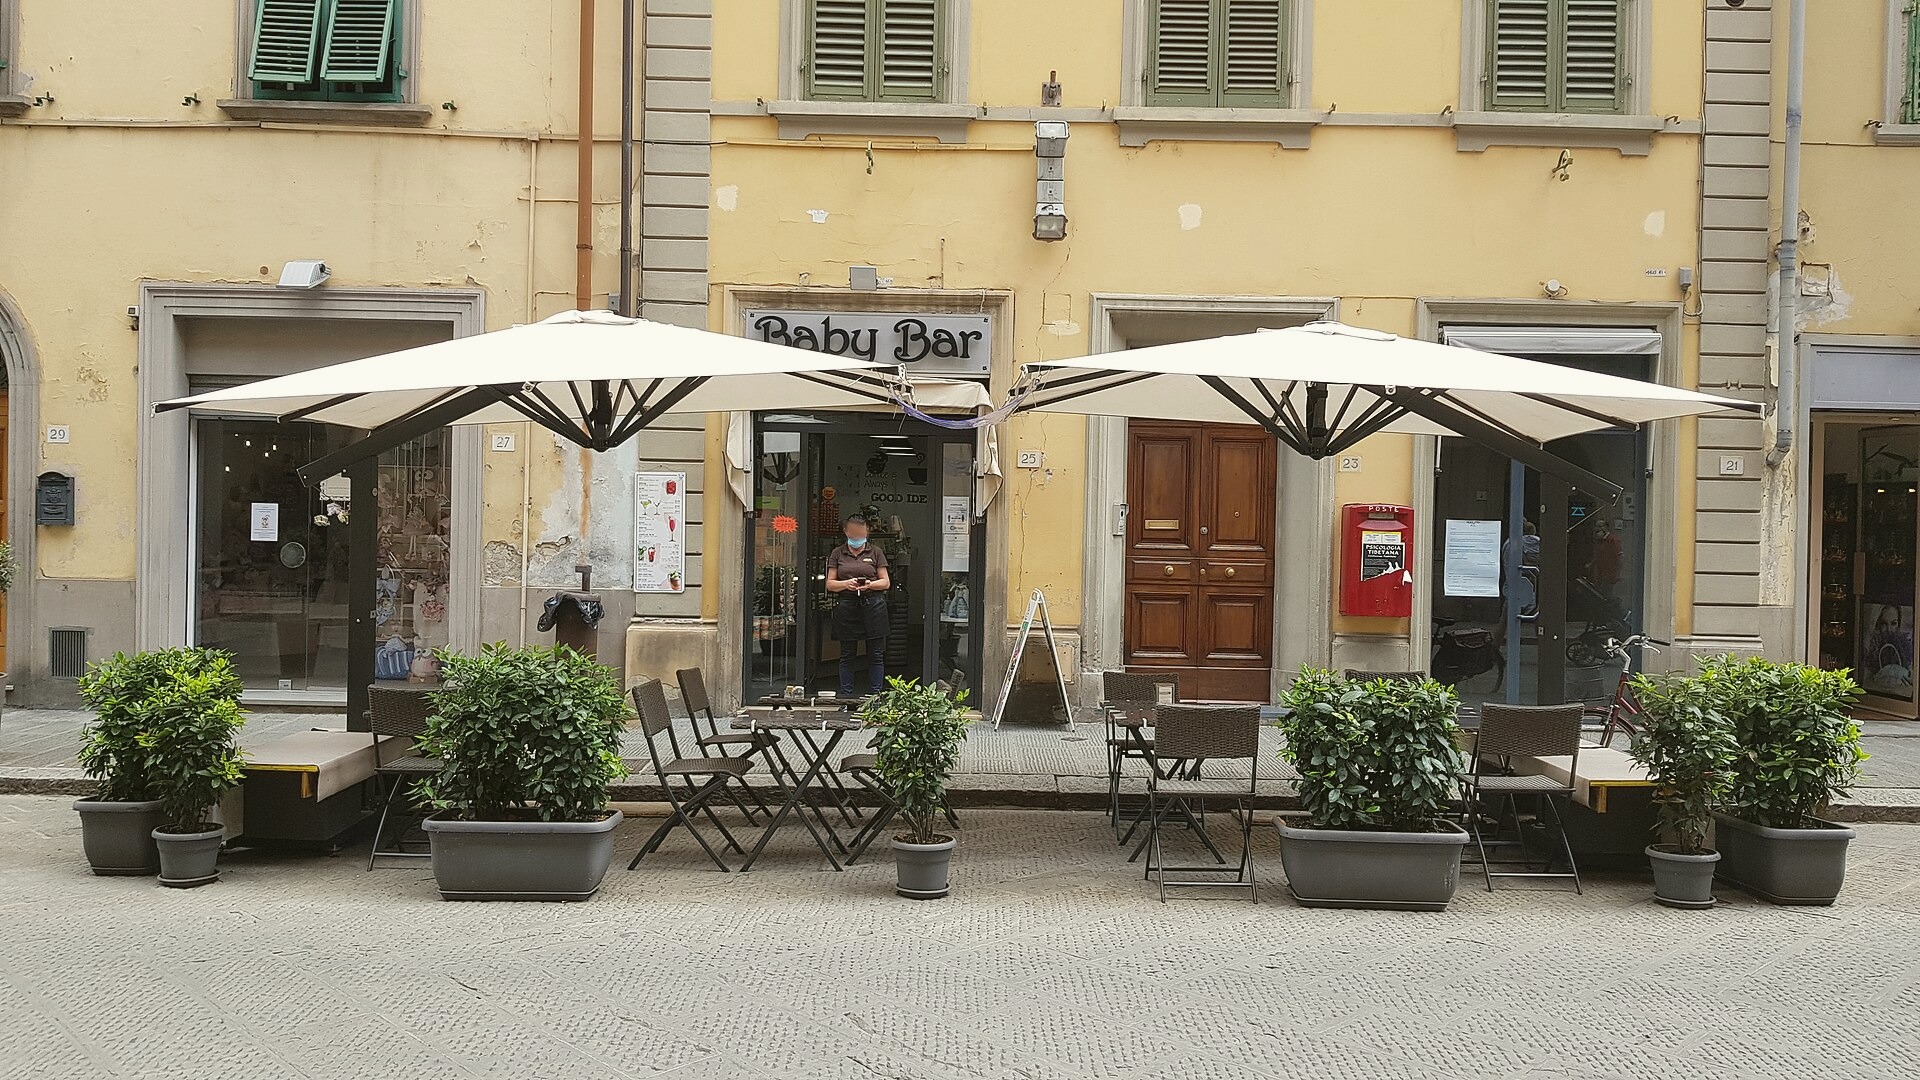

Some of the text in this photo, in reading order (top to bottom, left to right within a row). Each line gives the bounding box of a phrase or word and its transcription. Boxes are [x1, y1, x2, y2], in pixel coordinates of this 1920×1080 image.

[754, 315, 983, 363] Baby Bar
[50, 428, 66, 440] 29
[496, 436, 510, 448] 27
[1021, 453, 1037, 464] 25
[1342, 458, 1359, 469] 23
[1726, 460, 1738, 471] 21
[870, 493, 904, 503] GOOD
[1368, 505, 1400, 513] POSTE
